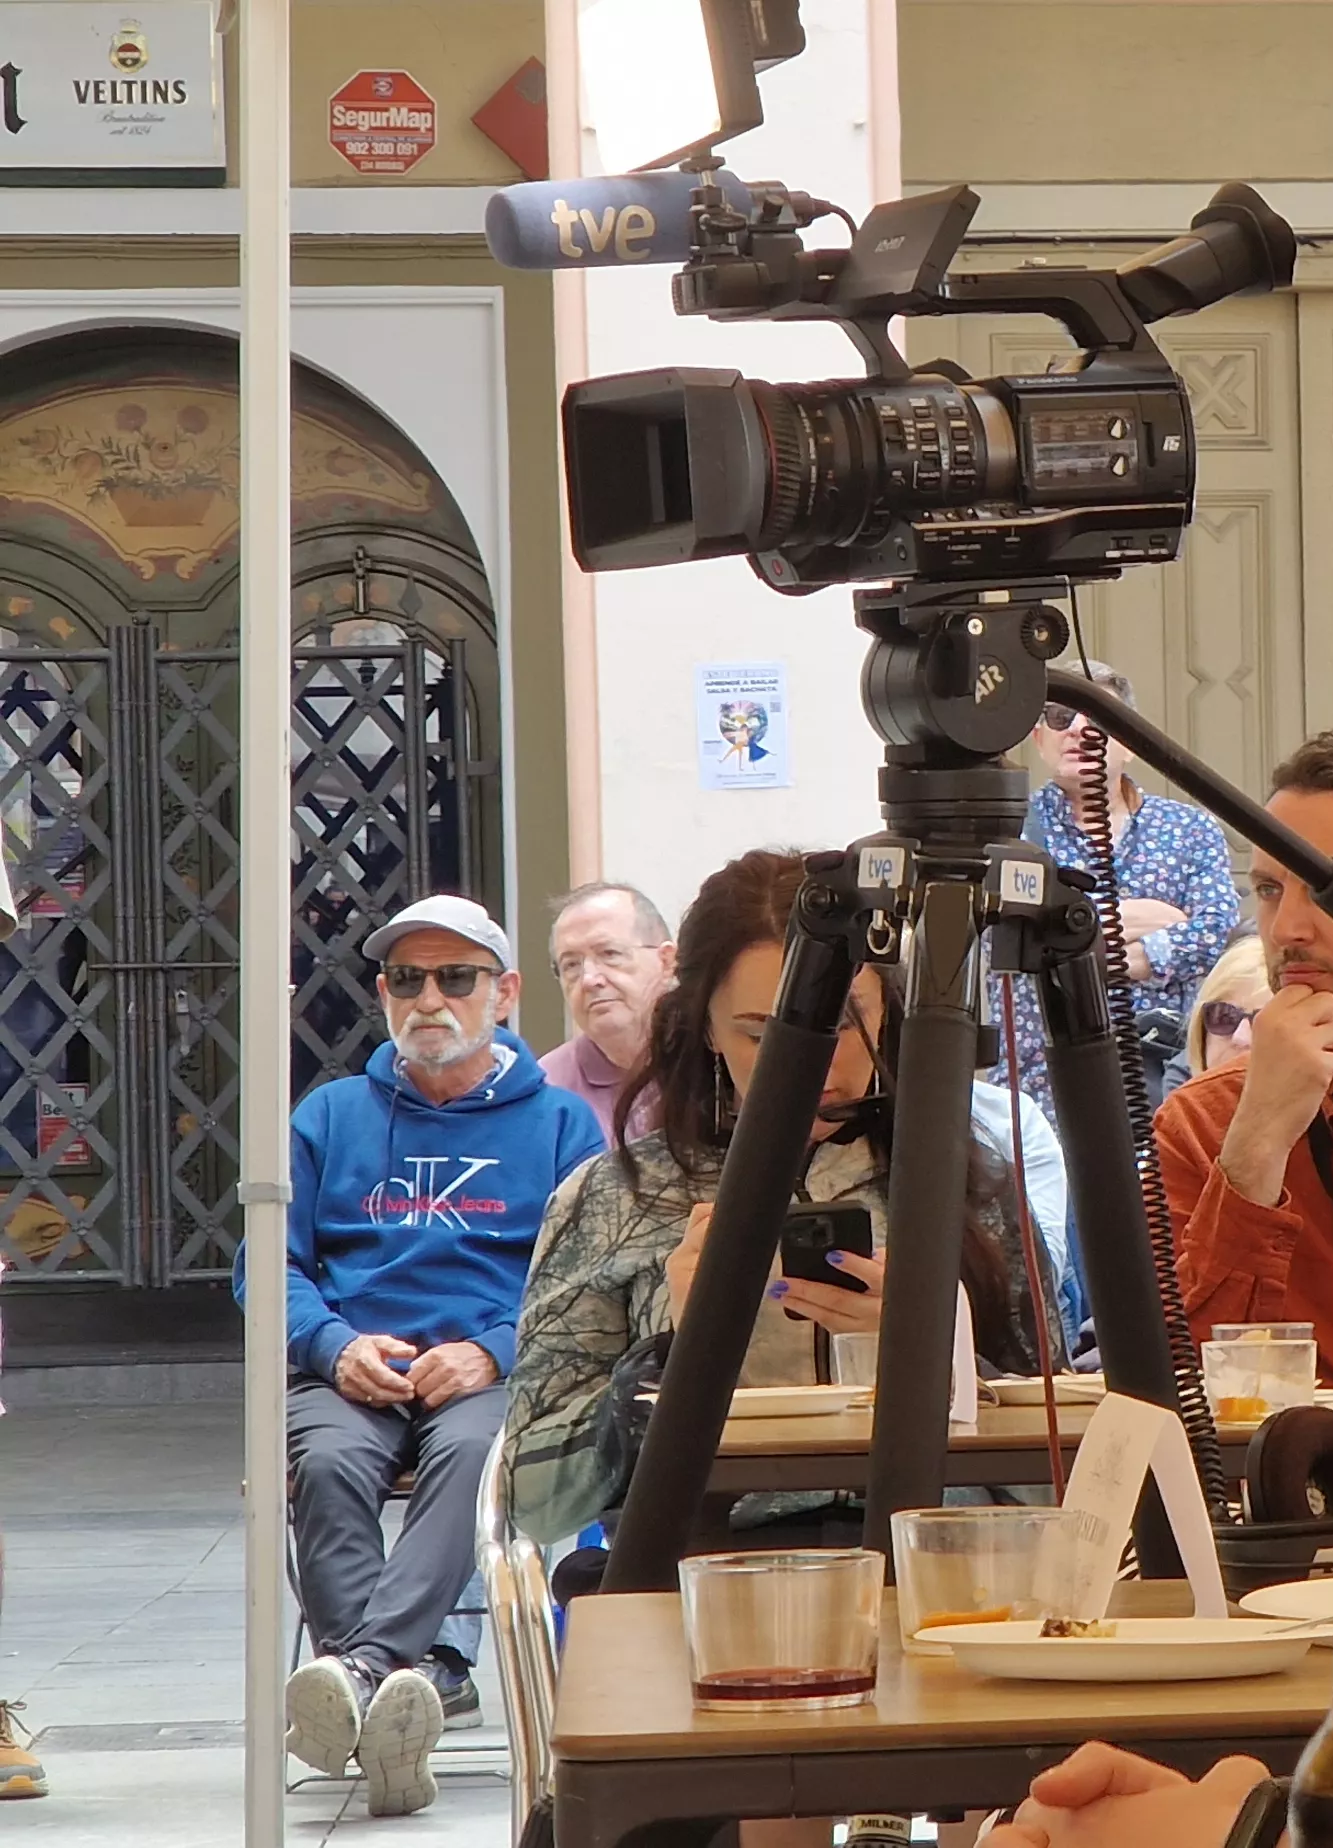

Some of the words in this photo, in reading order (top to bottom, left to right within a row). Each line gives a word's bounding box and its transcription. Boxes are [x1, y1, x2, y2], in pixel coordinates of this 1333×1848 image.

[72, 79, 187, 105] VELTINS
[332, 104, 433, 133] SegurMap
[371, 142, 394, 155] 300
[550, 199, 656, 261] tve
[868, 854, 892, 885] tve
[1013, 867, 1037, 899] tve
